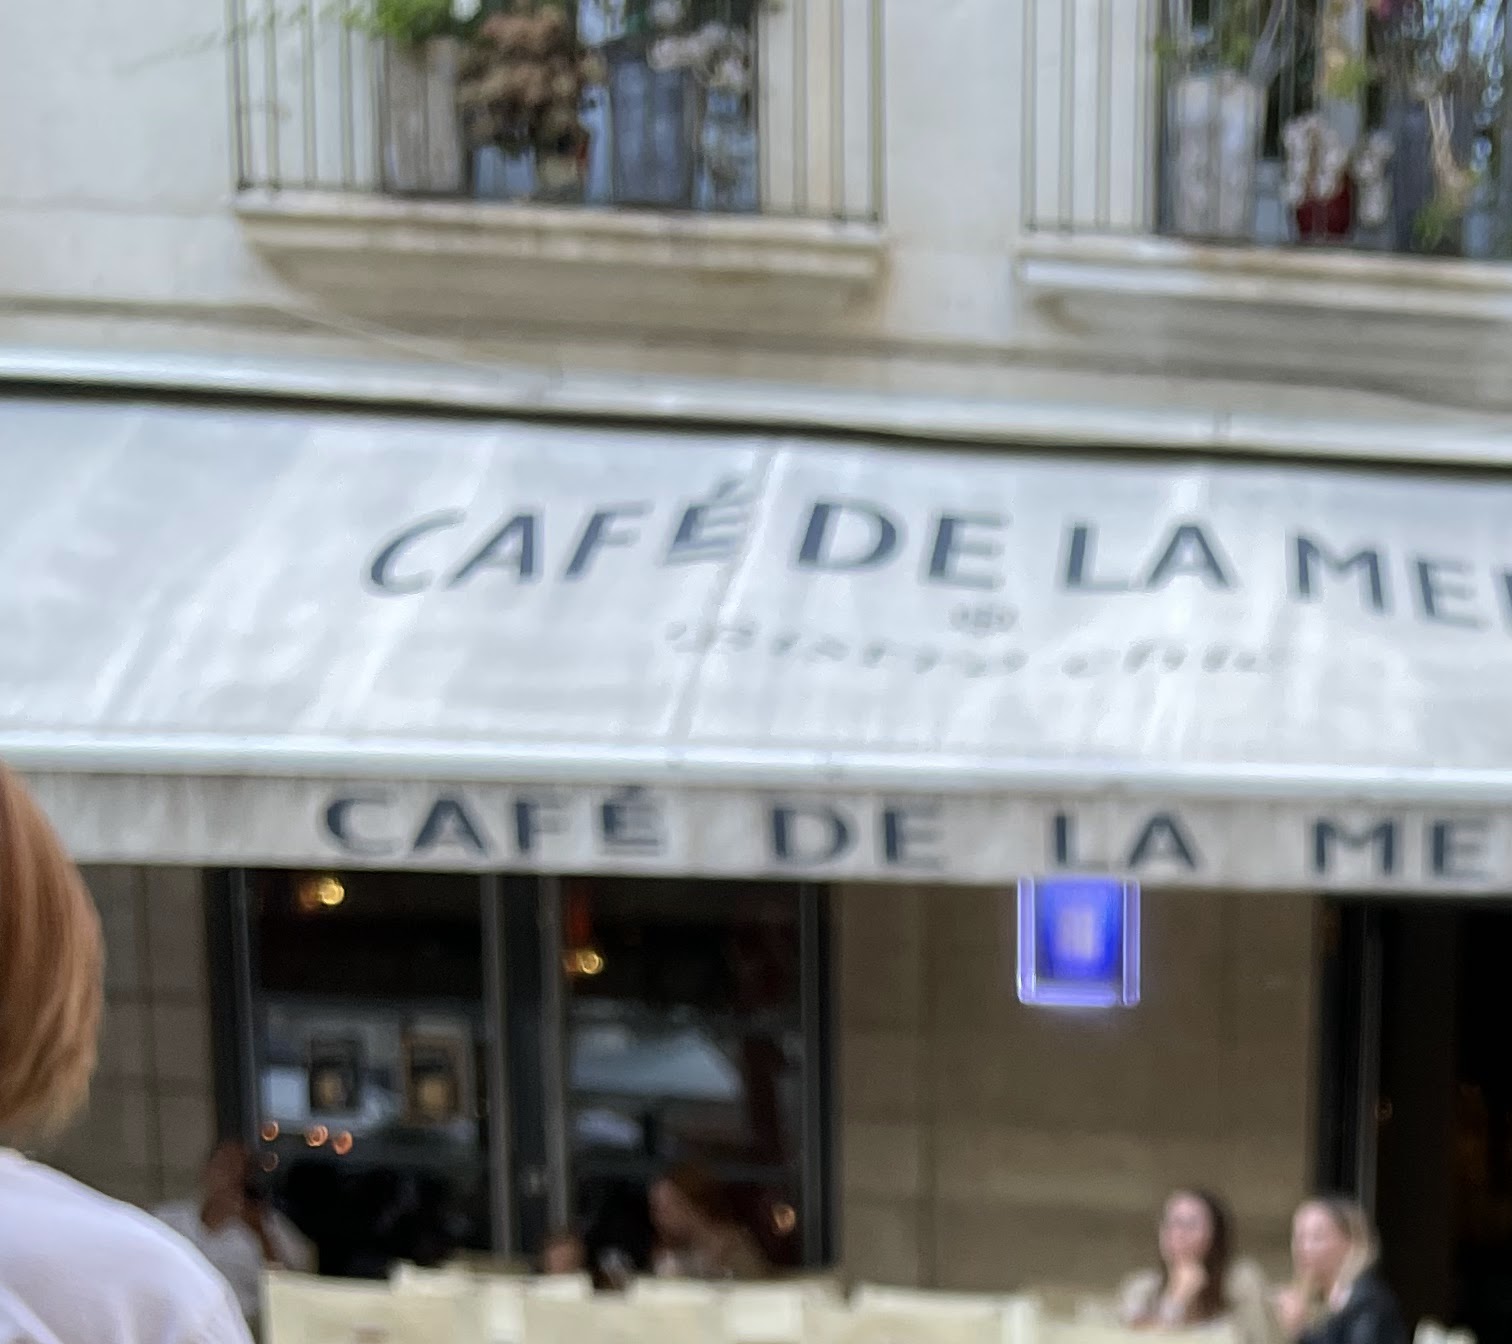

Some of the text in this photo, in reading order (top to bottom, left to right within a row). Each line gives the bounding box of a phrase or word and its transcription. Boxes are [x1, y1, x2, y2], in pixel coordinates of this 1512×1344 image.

[364, 474, 751, 597] CAFÉ
[797, 499, 1012, 589] DE
[1062, 521, 1235, 592] LA
[324, 784, 664, 858] CAFÉ
[770, 803, 947, 872] DE
[1049, 809, 1207, 873] LA
